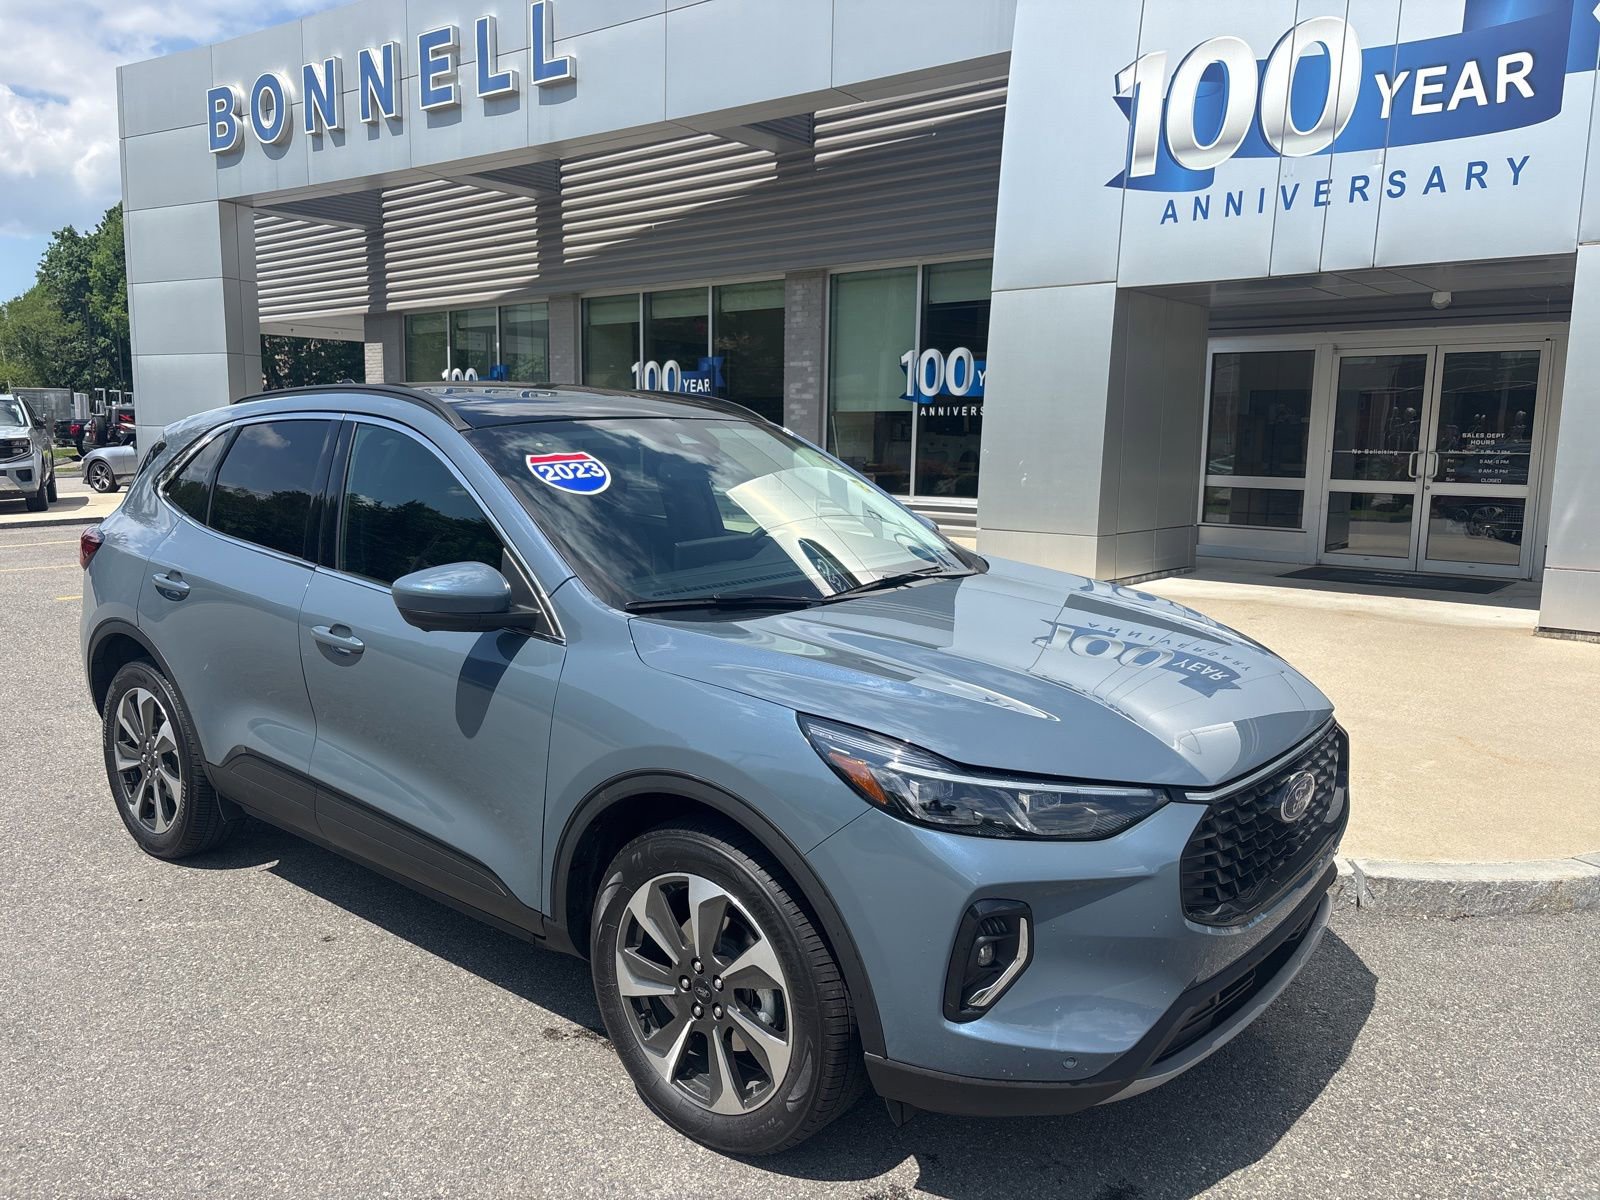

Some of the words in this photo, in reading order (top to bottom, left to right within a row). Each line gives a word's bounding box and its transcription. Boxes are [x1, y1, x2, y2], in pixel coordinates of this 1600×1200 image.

[206, 0, 576, 153] BONNELL
[1114, 16, 1362, 178] 100
[1373, 50, 1535, 120] YEAR
[1159, 155, 1531, 225] ANNIVERSARY
[631, 359, 682, 392] 100
[683, 378, 711, 393] YEAR
[900, 346, 975, 397] 100
[537, 462, 605, 481] 2023
